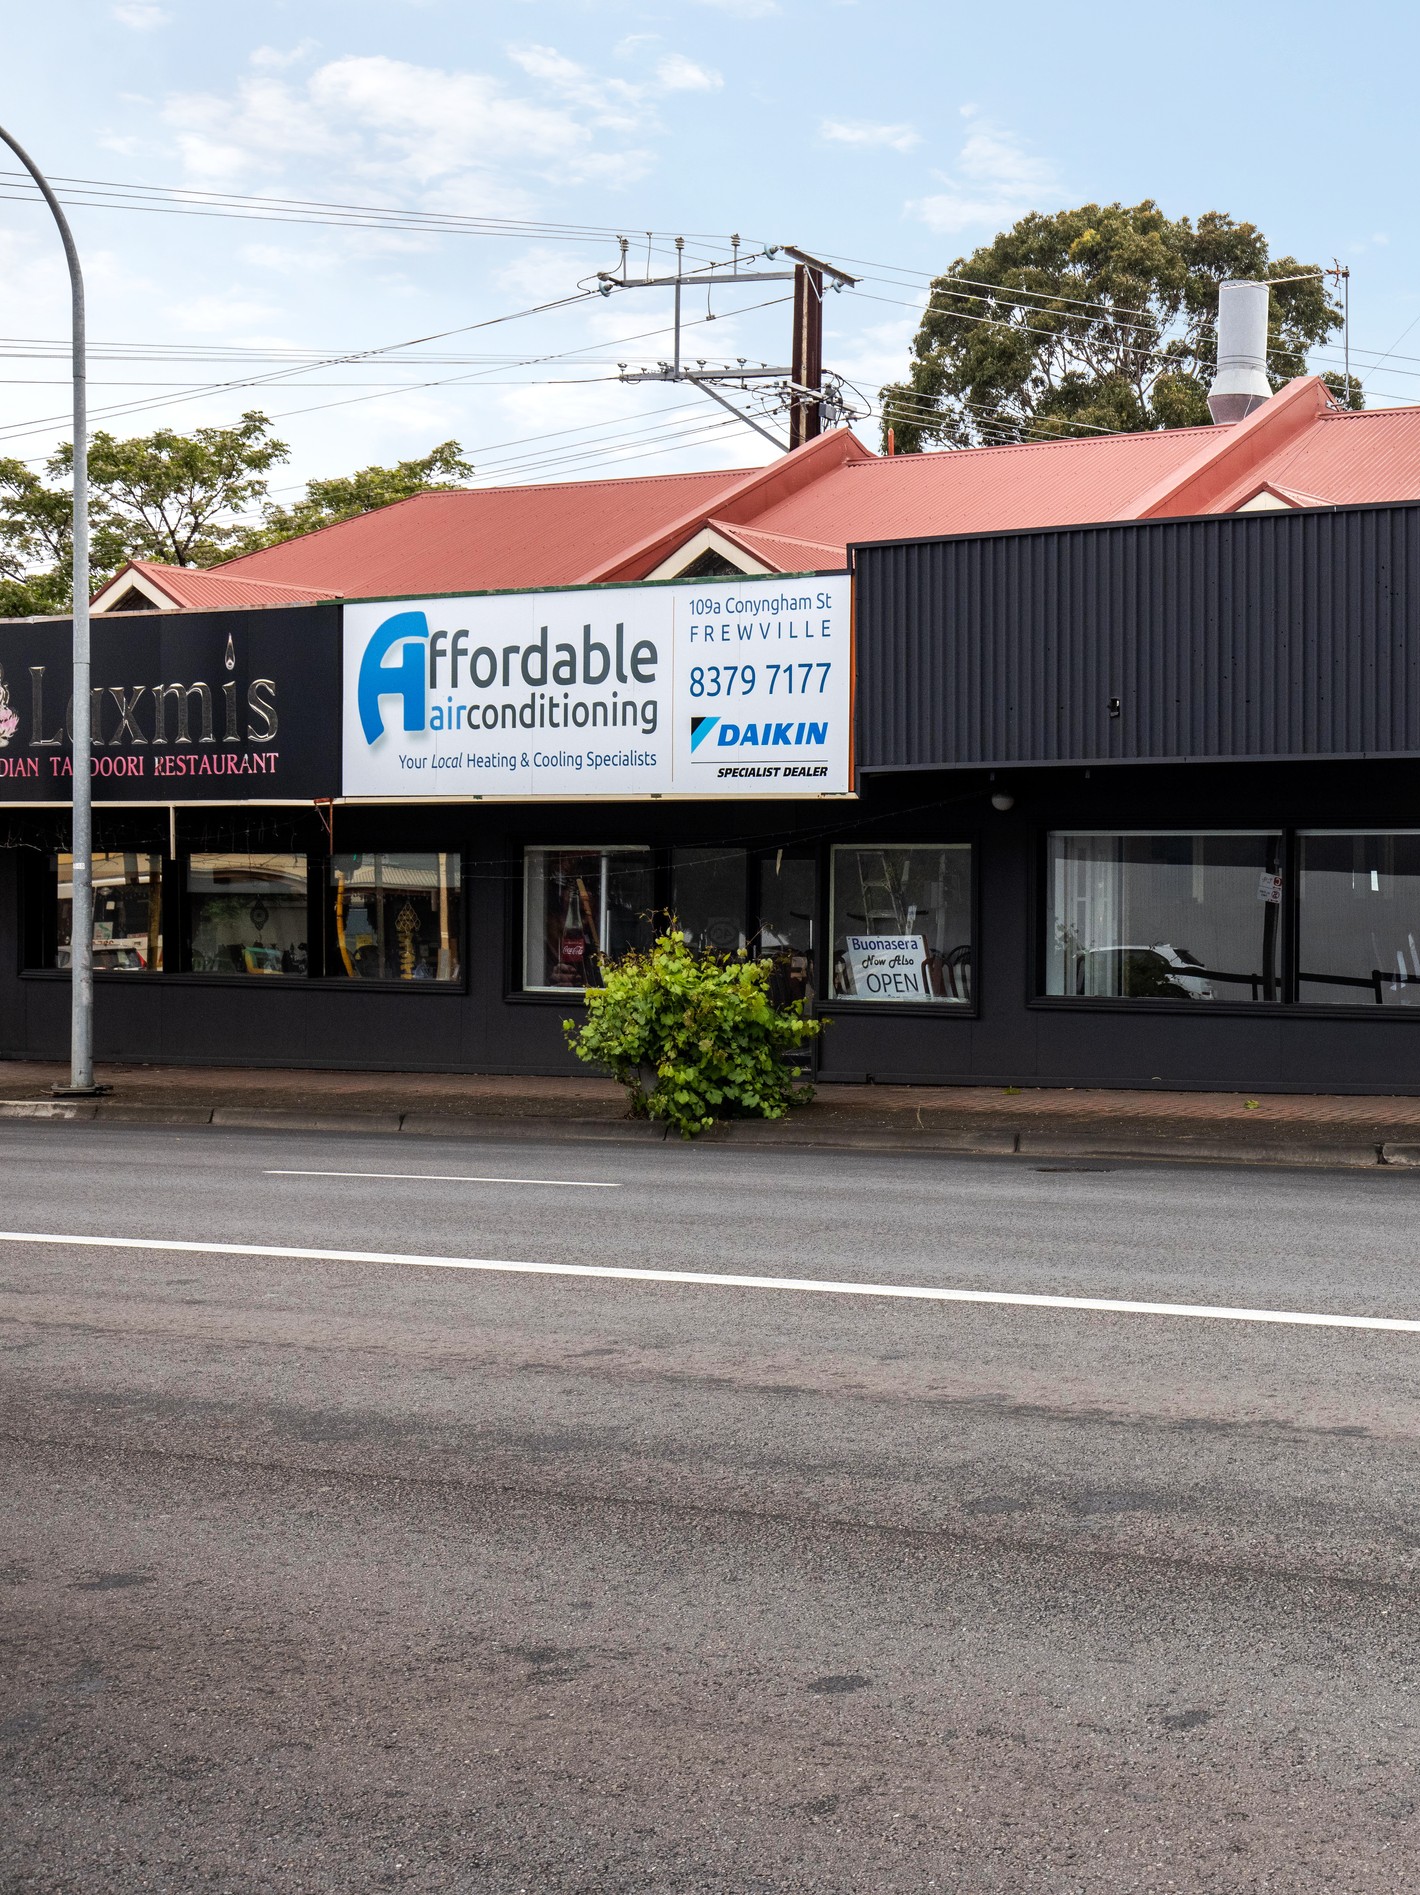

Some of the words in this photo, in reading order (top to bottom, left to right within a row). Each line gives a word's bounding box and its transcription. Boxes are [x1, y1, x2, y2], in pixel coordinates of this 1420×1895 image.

[689, 598, 722, 616] 109a
[725, 594, 812, 618] Conyngham
[816, 593, 832, 610] St
[690, 620, 832, 642] FREWVILLE
[358, 610, 658, 746] Affordable
[690, 664, 756, 698] 8379
[766, 662, 832, 695] 7177
[430, 691, 658, 734] airconditioning
[718, 722, 829, 746] DAIKIN
[50, 756, 144, 776] TADOORI
[154, 753, 279, 776] RESTAURANT
[398, 754, 428, 770] Your
[431, 752, 462, 770] Local
[466, 752, 518, 772] Heating
[521, 752, 530, 768] &
[533, 752, 584, 771] Cooling
[587, 750, 657, 771] Specialists
[718, 766, 780, 778] SPECIALIST
[782, 766, 829, 778] DEALER
[852, 938, 918, 951] Buonasera
[862, 955, 886, 969] Now
[888, 955, 914, 969] Also
[866, 974, 919, 993] OPEN
